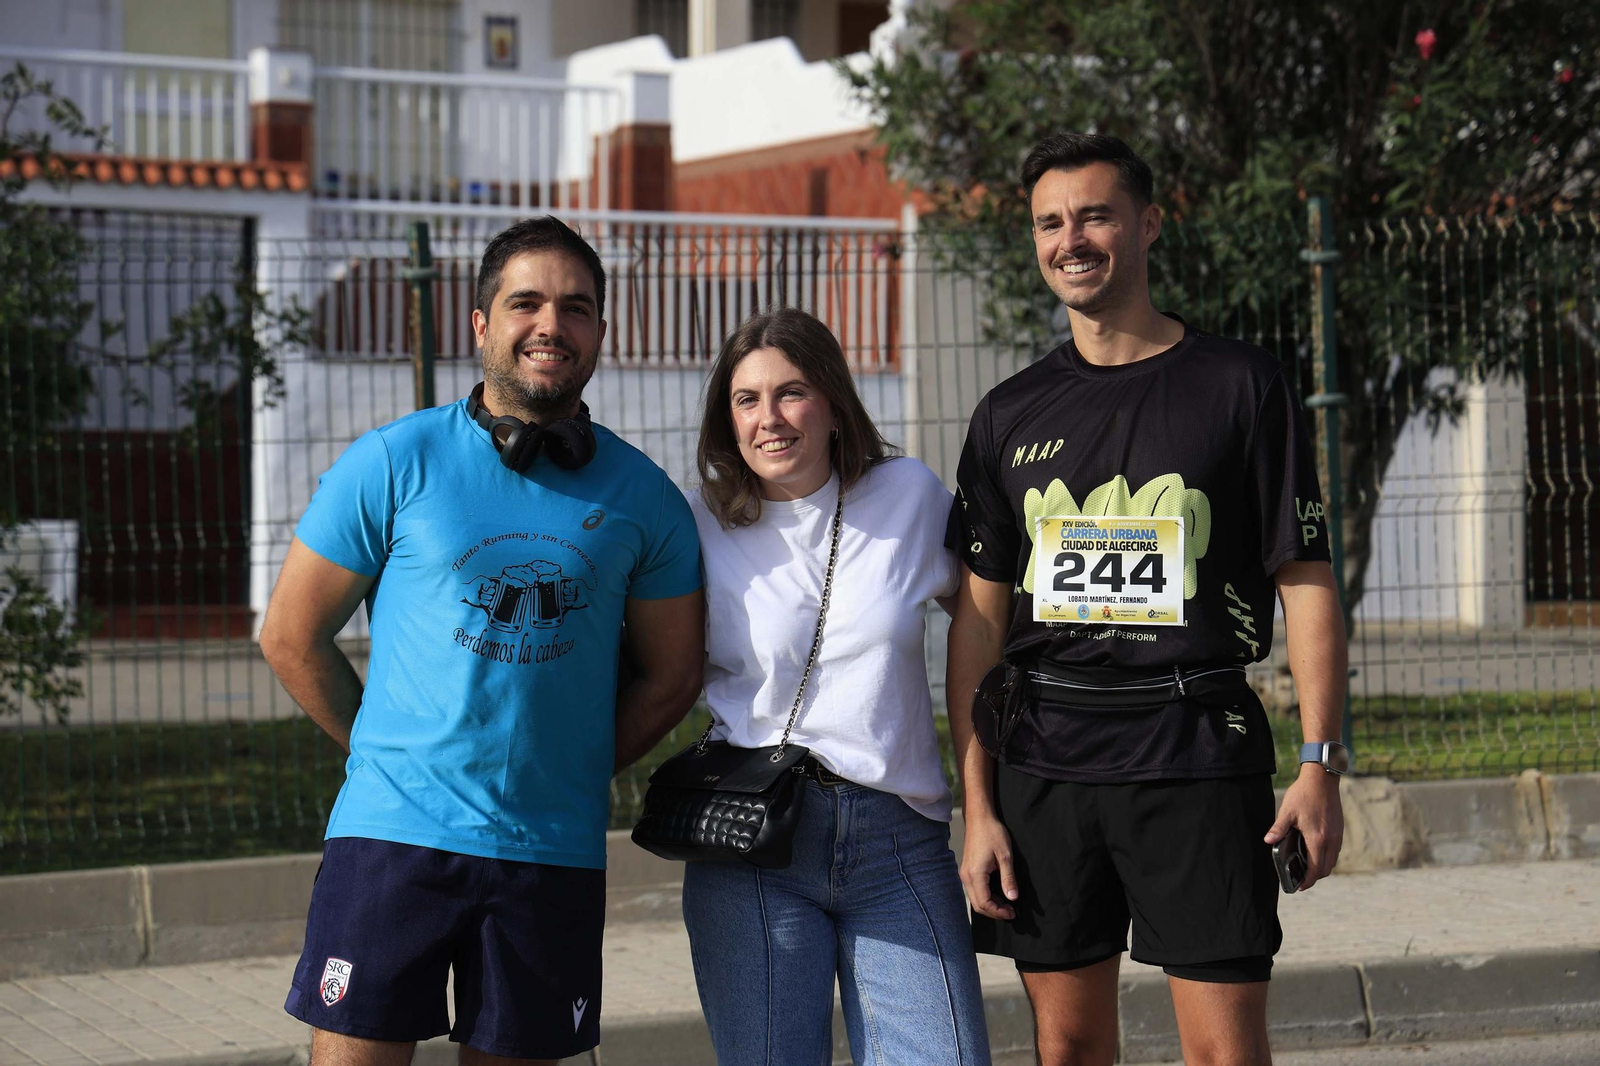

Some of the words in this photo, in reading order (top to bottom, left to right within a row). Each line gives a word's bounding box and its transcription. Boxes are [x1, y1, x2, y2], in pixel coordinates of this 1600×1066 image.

[1011, 438, 1064, 468] MAAP
[1060, 528, 1109, 540] CARRERA
[1110, 528, 1158, 541] URBANA
[451, 544, 480, 572] Tanto
[481, 531, 529, 546] Running
[529, 532, 539, 542] y
[540, 534, 558, 543] sin
[1061, 540, 1095, 551] CIUDAD
[1096, 540, 1108, 551] DE
[1109, 541, 1158, 552] ALGECIRAS
[1052, 552, 1167, 594] 244
[1068, 595, 1089, 603] LOBATO
[1119, 596, 1148, 604] FERNANDO
[1117, 629, 1157, 642] PERFORM
[453, 627, 516, 664] Perdemos
[517, 632, 532, 665] la
[535, 633, 576, 664] cabeza
[327, 960, 351, 976] SRC
